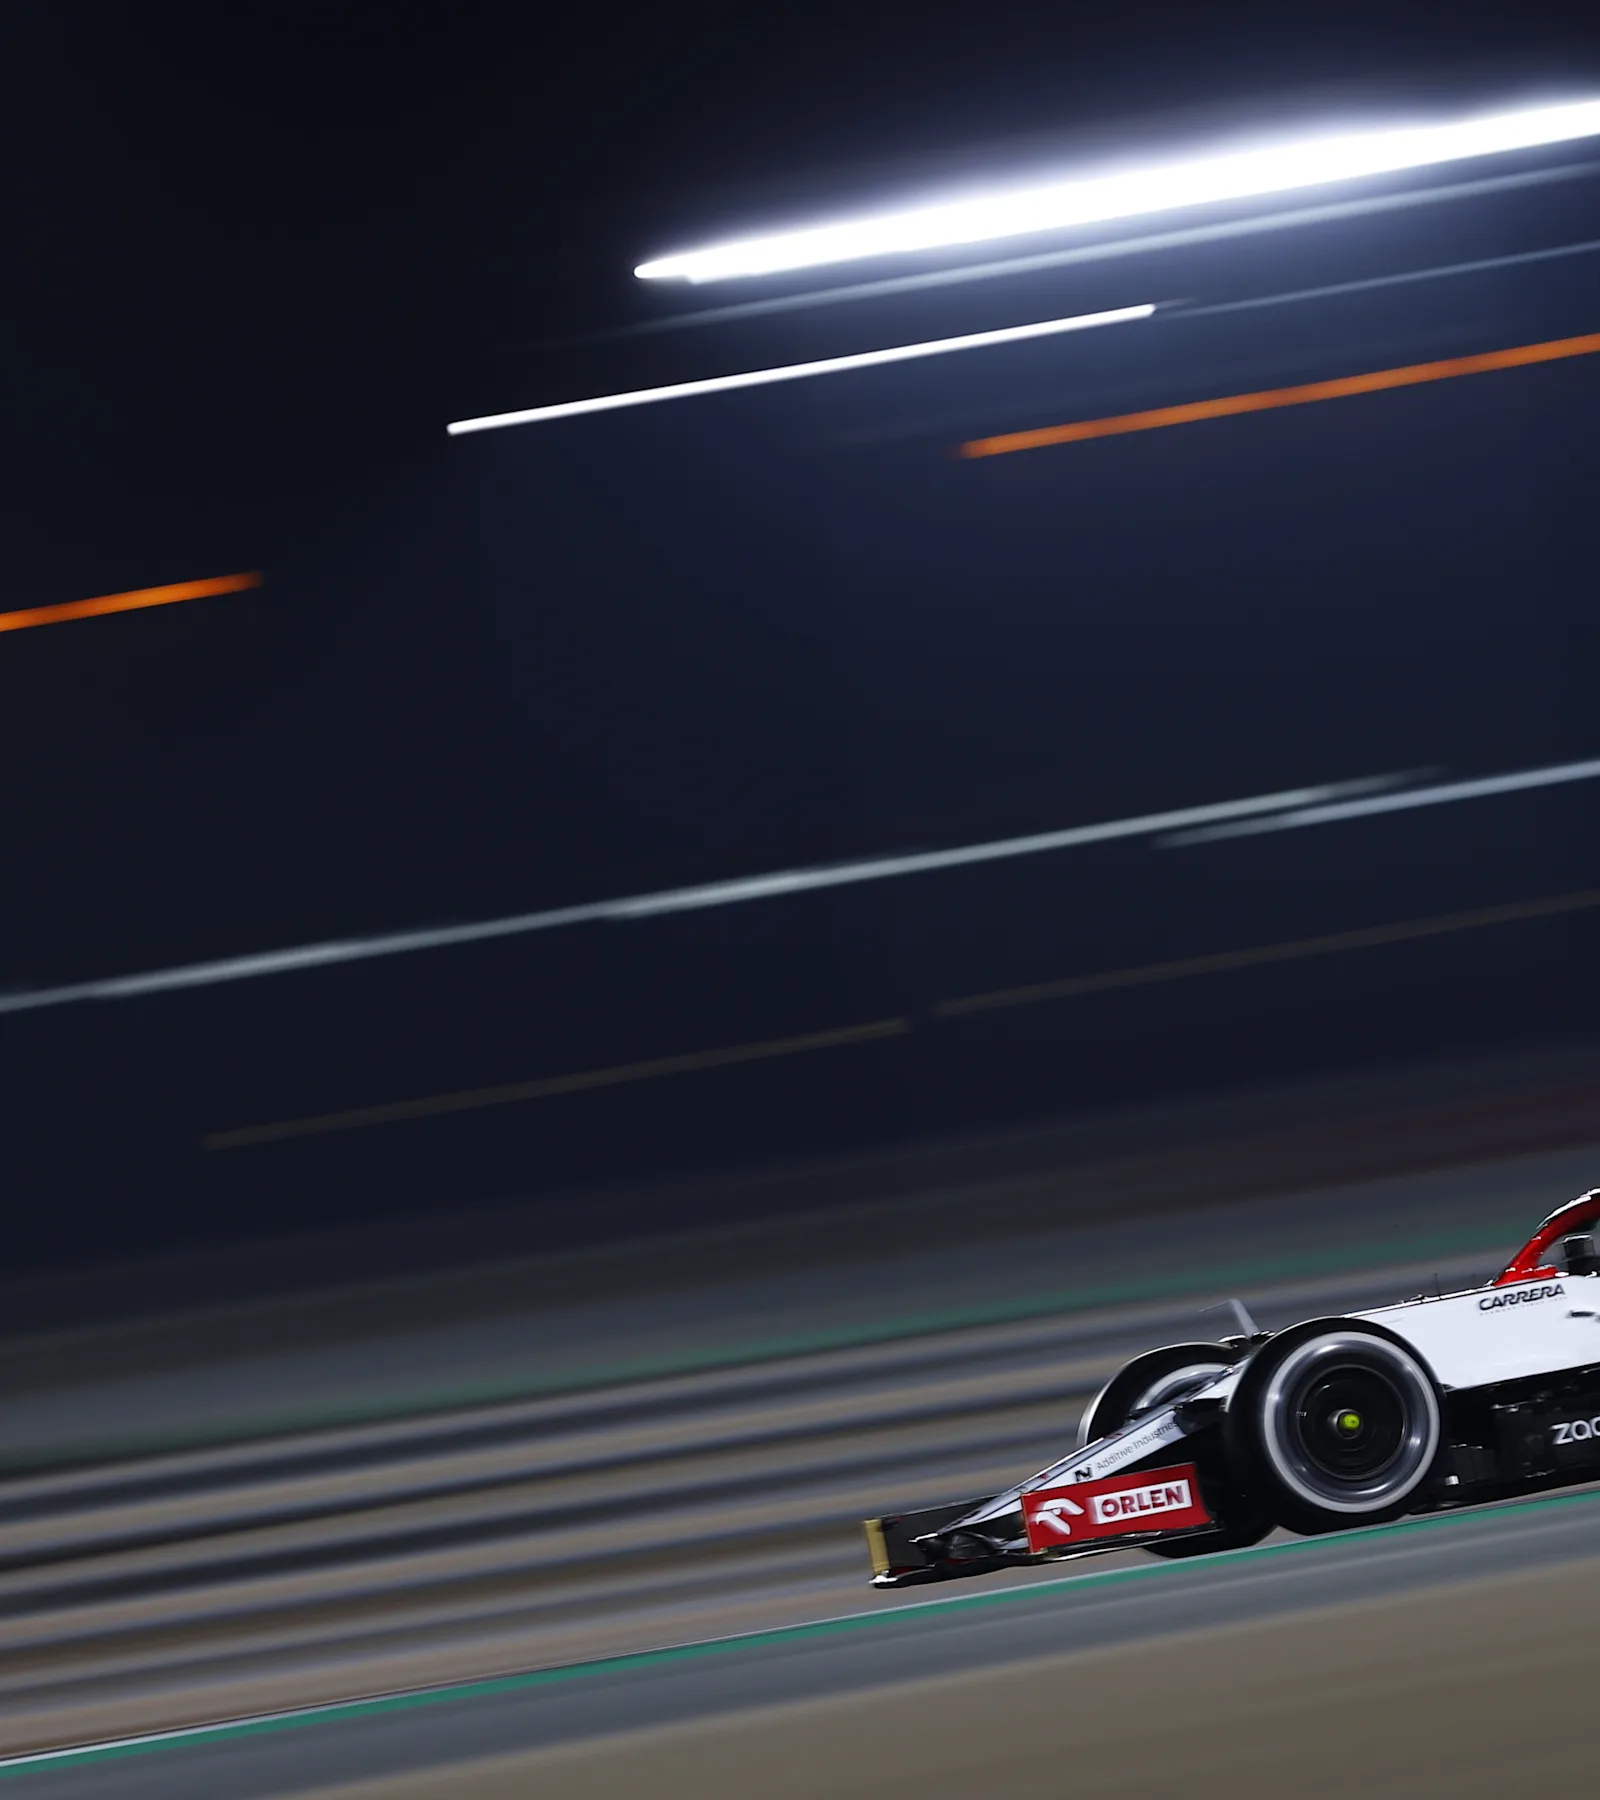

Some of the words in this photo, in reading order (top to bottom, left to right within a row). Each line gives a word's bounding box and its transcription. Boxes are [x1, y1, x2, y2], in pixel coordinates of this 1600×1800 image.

[1479, 1284, 1566, 1311] CARRERA
[1097, 1445, 1134, 1470] Additive
[1101, 1485, 1184, 1518] ORLEN
